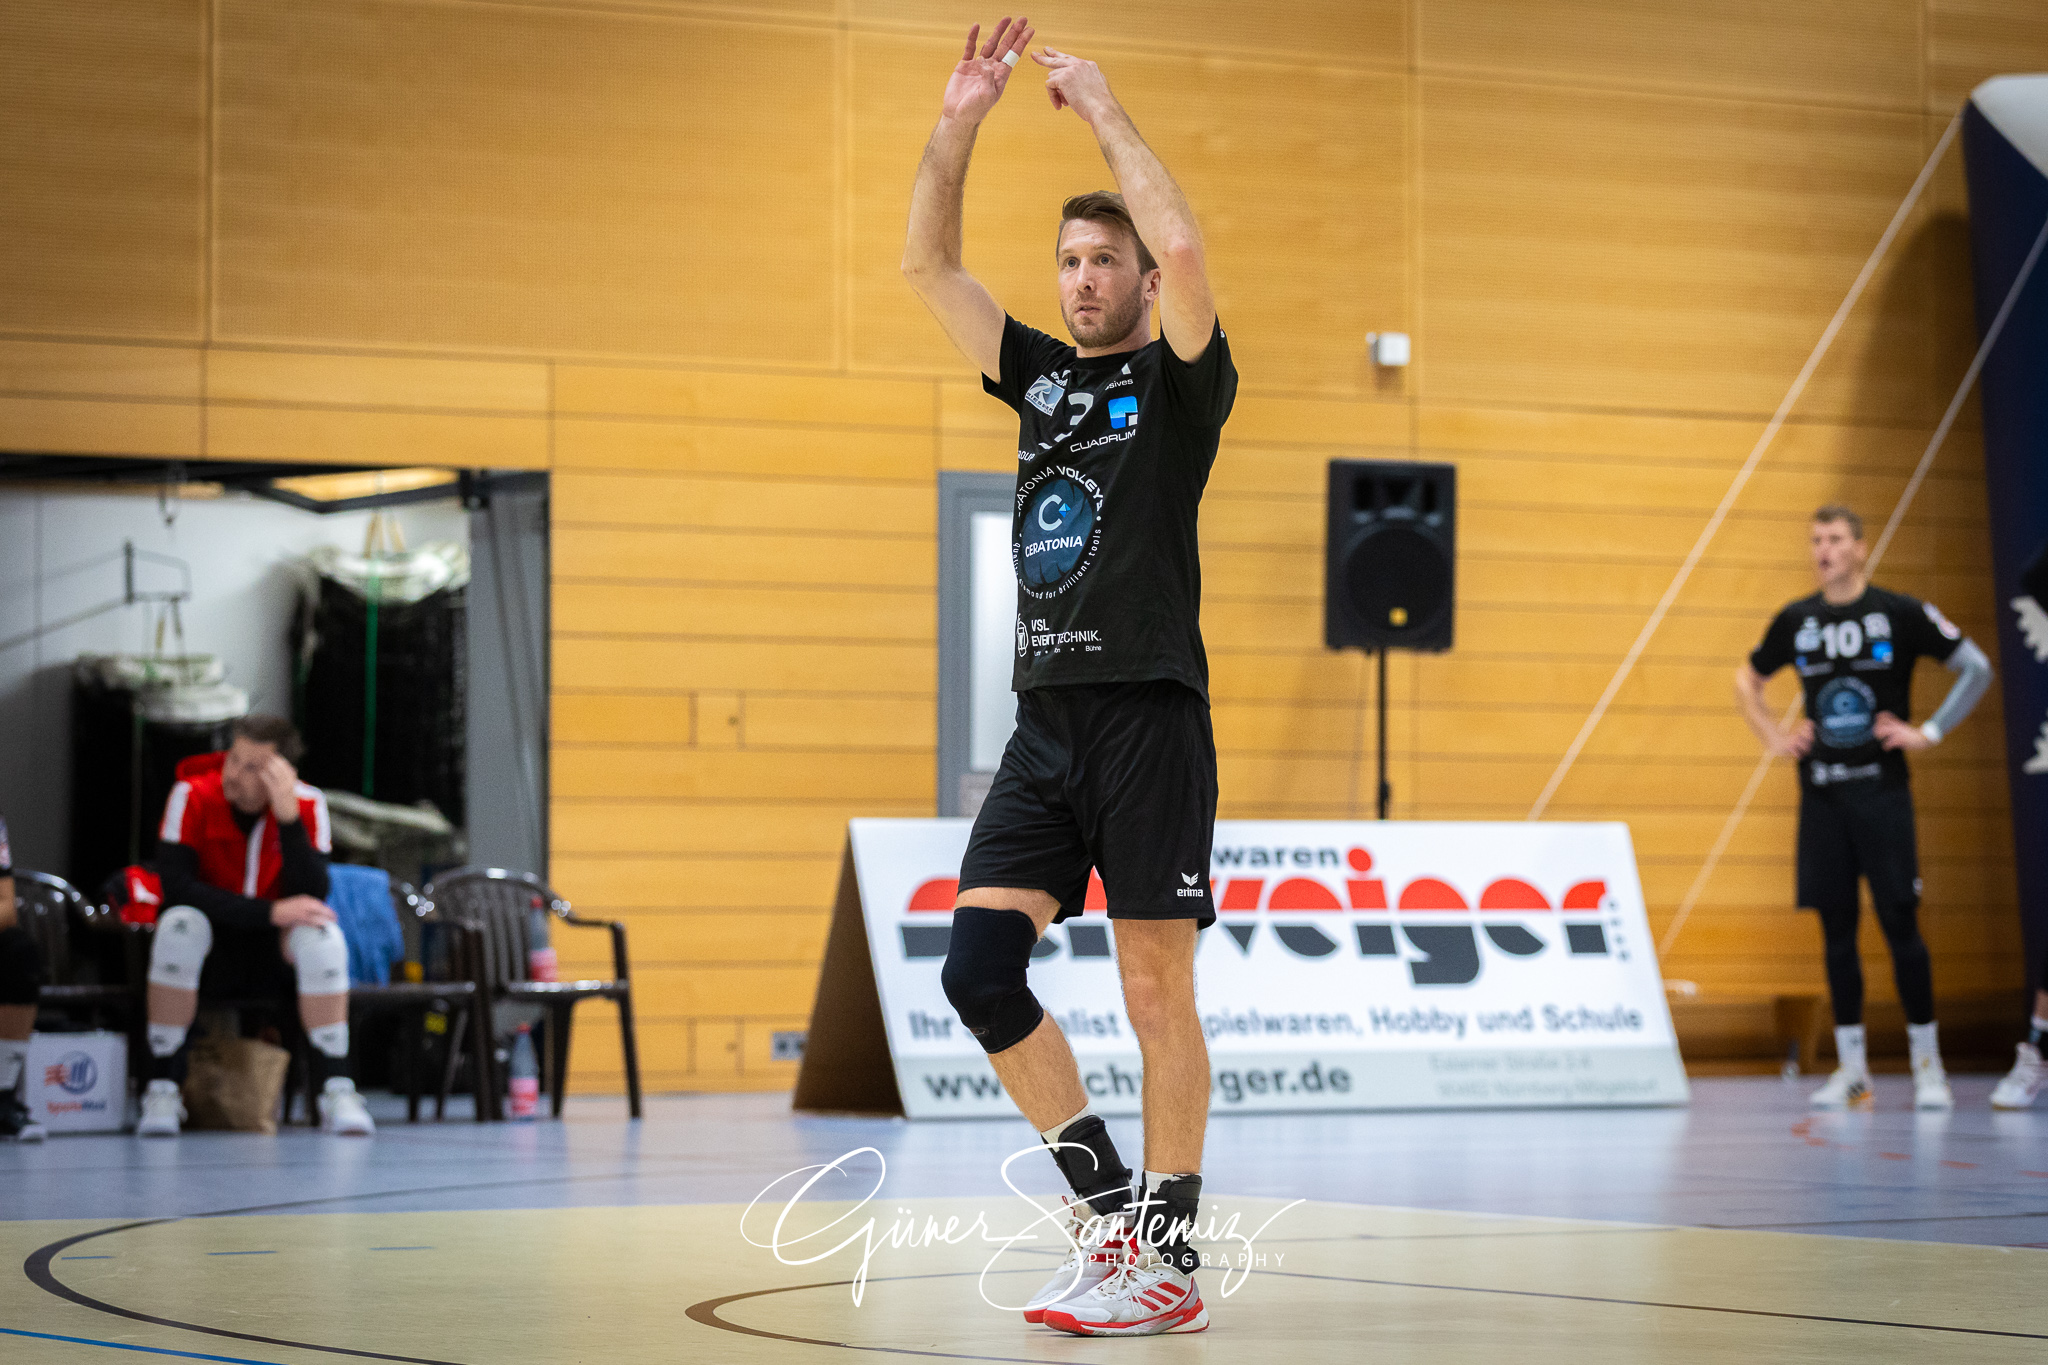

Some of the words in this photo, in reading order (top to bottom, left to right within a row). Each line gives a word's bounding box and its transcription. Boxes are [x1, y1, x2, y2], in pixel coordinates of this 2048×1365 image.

[1070, 428, 1137, 453] CUADRUM
[1024, 535, 1083, 558] CERATONIA
[1088, 529, 1102, 557] tools
[1031, 618, 1050, 632] VSL
[1821, 620, 1863, 659] 10
[1212, 846, 1340, 867] waren
[1176, 887, 1204, 897] erima
[908, 1010, 953, 1038] Ihr
[1204, 1007, 1364, 1040] pielwaren,
[1368, 1005, 1467, 1039] Hobby
[1476, 1004, 1534, 1032] und
[1541, 1003, 1643, 1033] Schule
